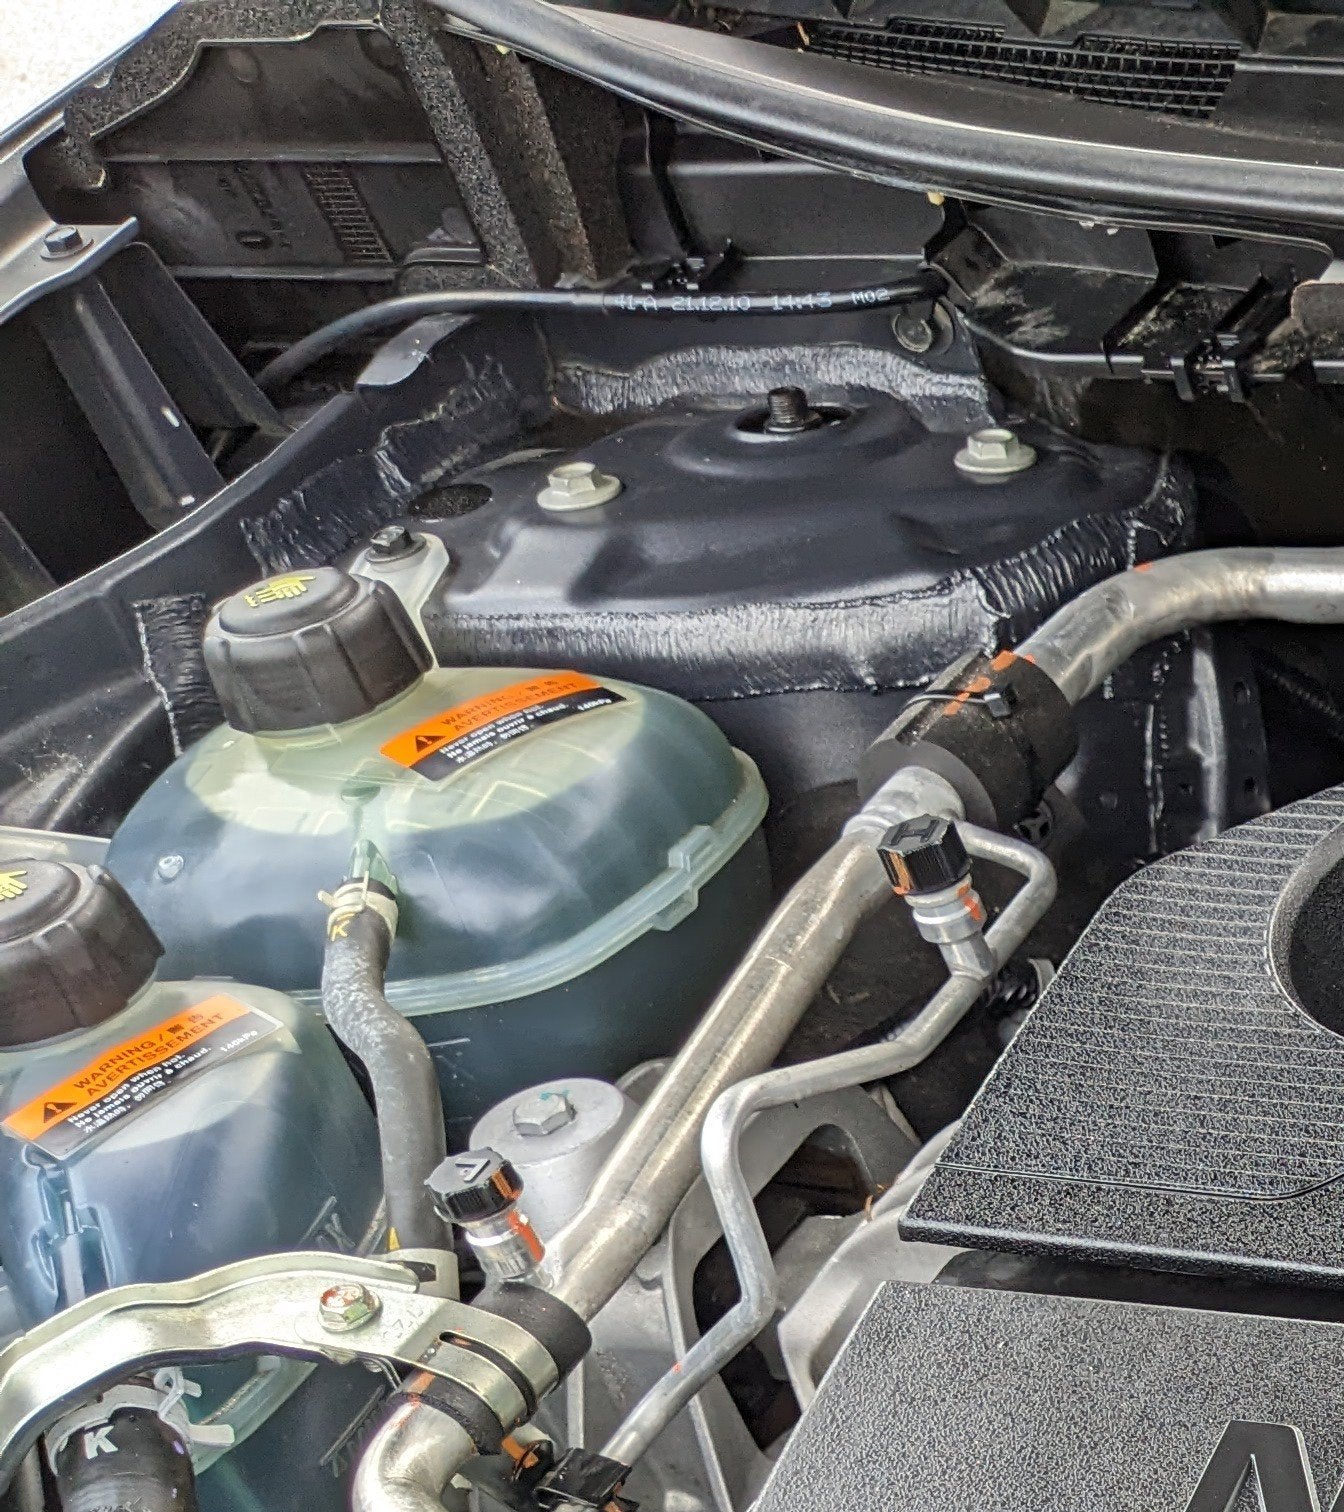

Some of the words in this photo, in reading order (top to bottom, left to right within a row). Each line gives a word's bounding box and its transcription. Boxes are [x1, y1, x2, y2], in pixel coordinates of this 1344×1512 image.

[74, 1040, 156, 1090] WARNING
[86, 1012, 224, 1096] AVERTISSEMENT
[67, 1102, 101, 1123] Never
[103, 1083, 130, 1103] open
[130, 1065, 162, 1083] when
[74, 1116, 93, 1128] Ne
[93, 1093, 131, 1118] jamais
[83, 1425, 119, 1460] K
